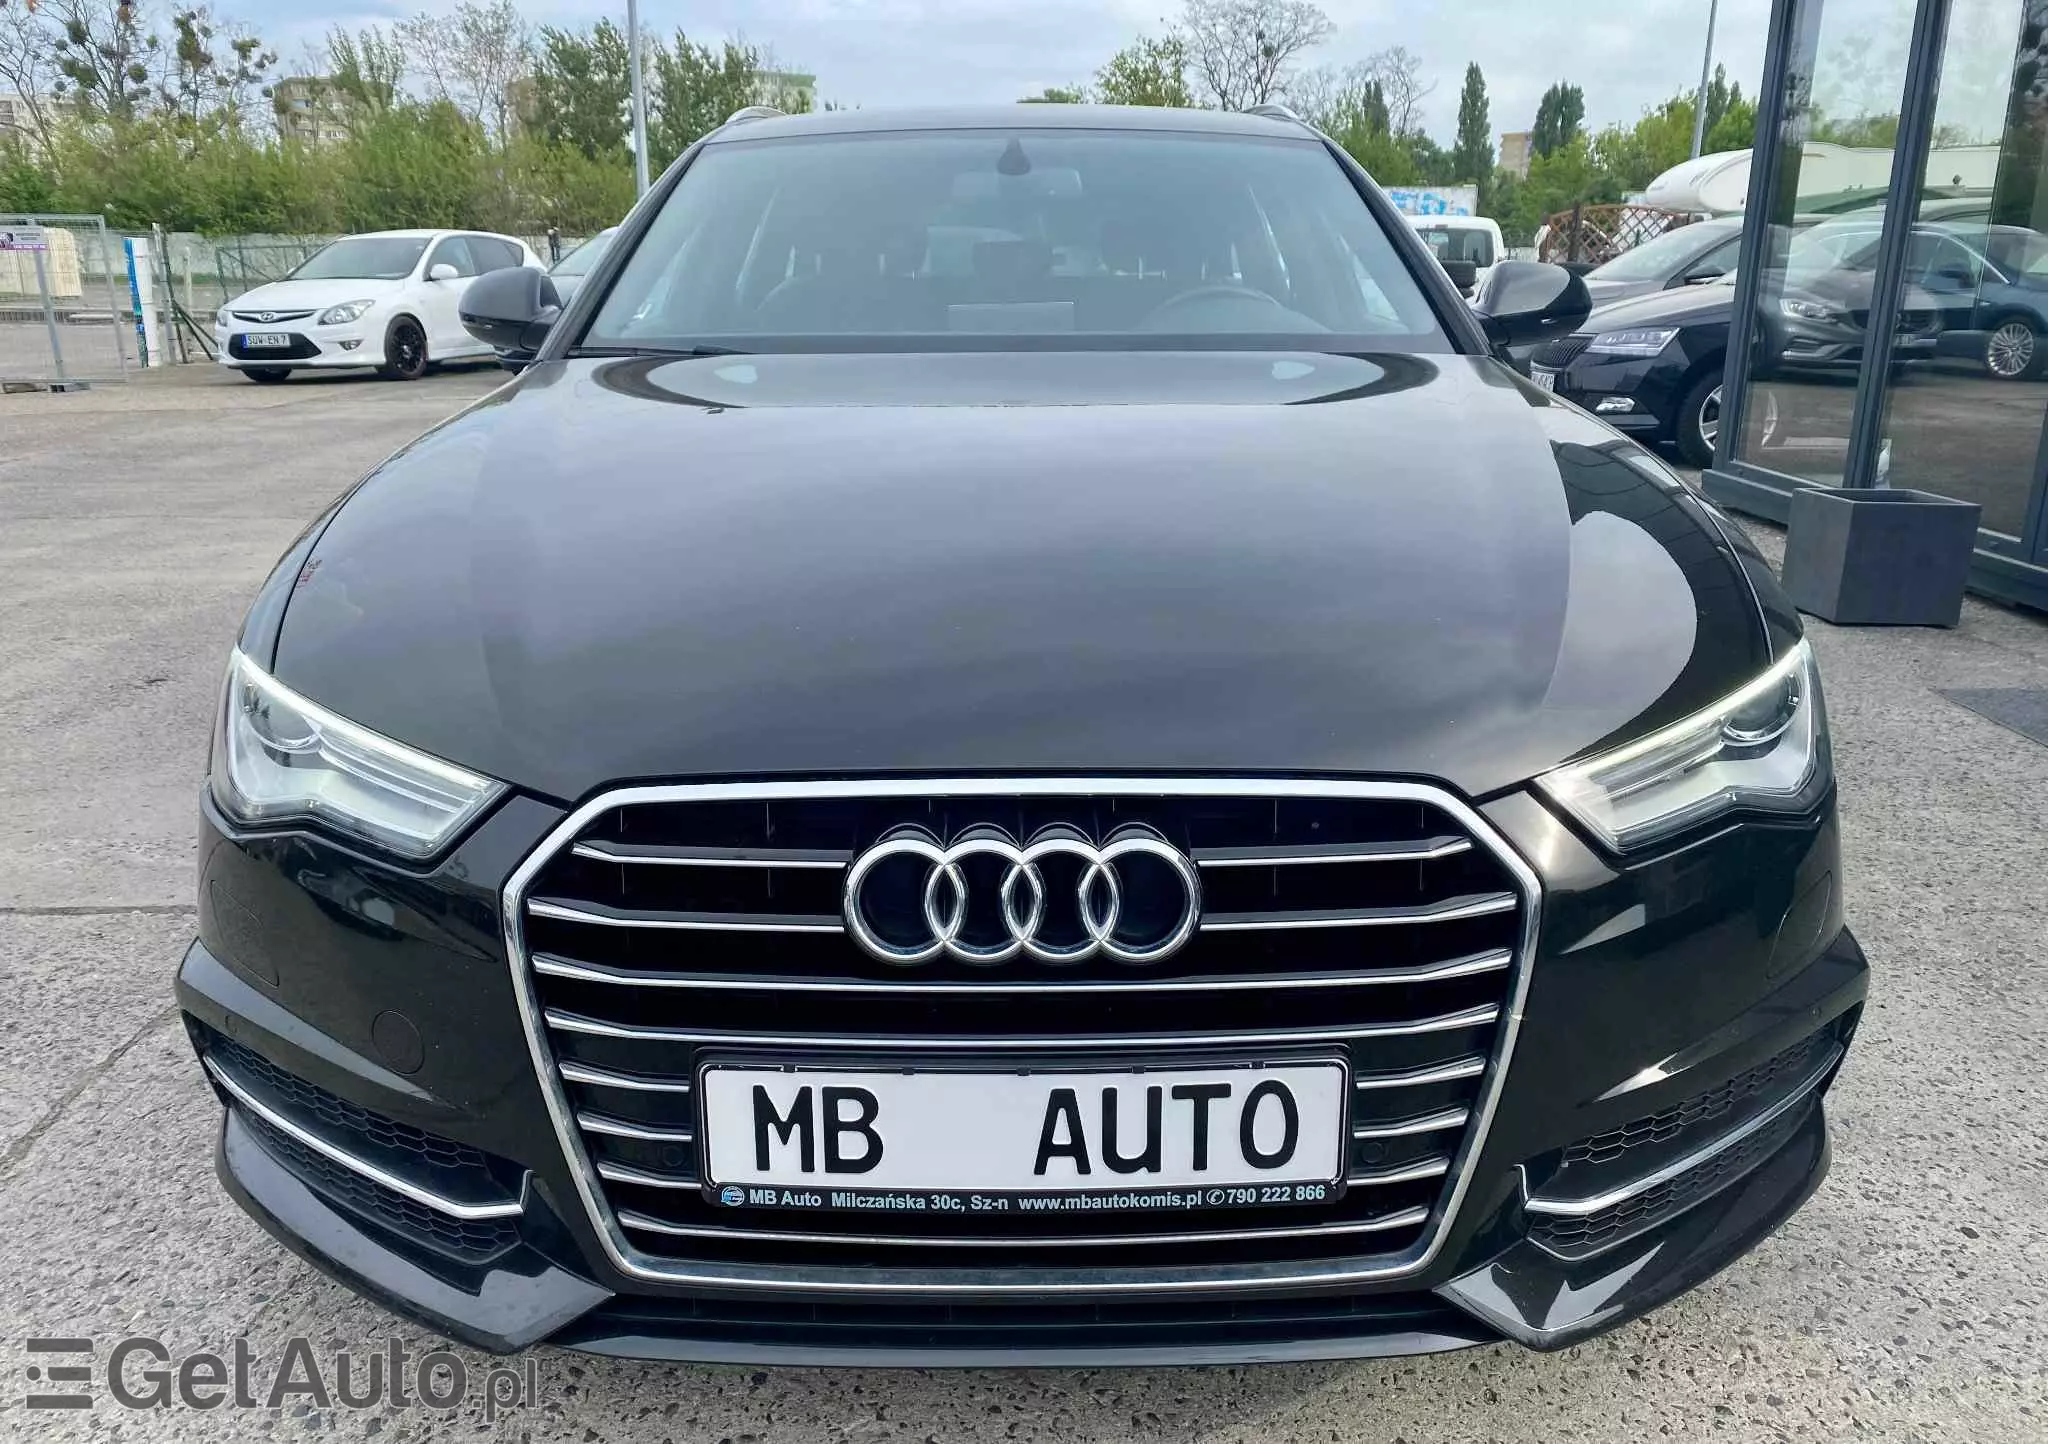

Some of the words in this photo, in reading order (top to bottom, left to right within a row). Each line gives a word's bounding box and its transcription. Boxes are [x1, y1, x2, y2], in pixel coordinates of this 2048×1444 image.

[752, 1084, 884, 1174] MB
[1033, 1079, 1300, 1176] AUTO
[749, 1189, 777, 1205] MB
[781, 1190, 822, 1207] Auto
[831, 1192, 926, 1209] Milczańska
[930, 1195, 966, 1212] 30c,
[970, 1195, 1009, 1210] Sz-n
[1018, 1190, 1202, 1210] www.mbautokomis.pl
[1226, 1188, 1257, 1204] 790
[1260, 1186, 1292, 1203] 222
[1295, 1184, 1325, 1201] 866
